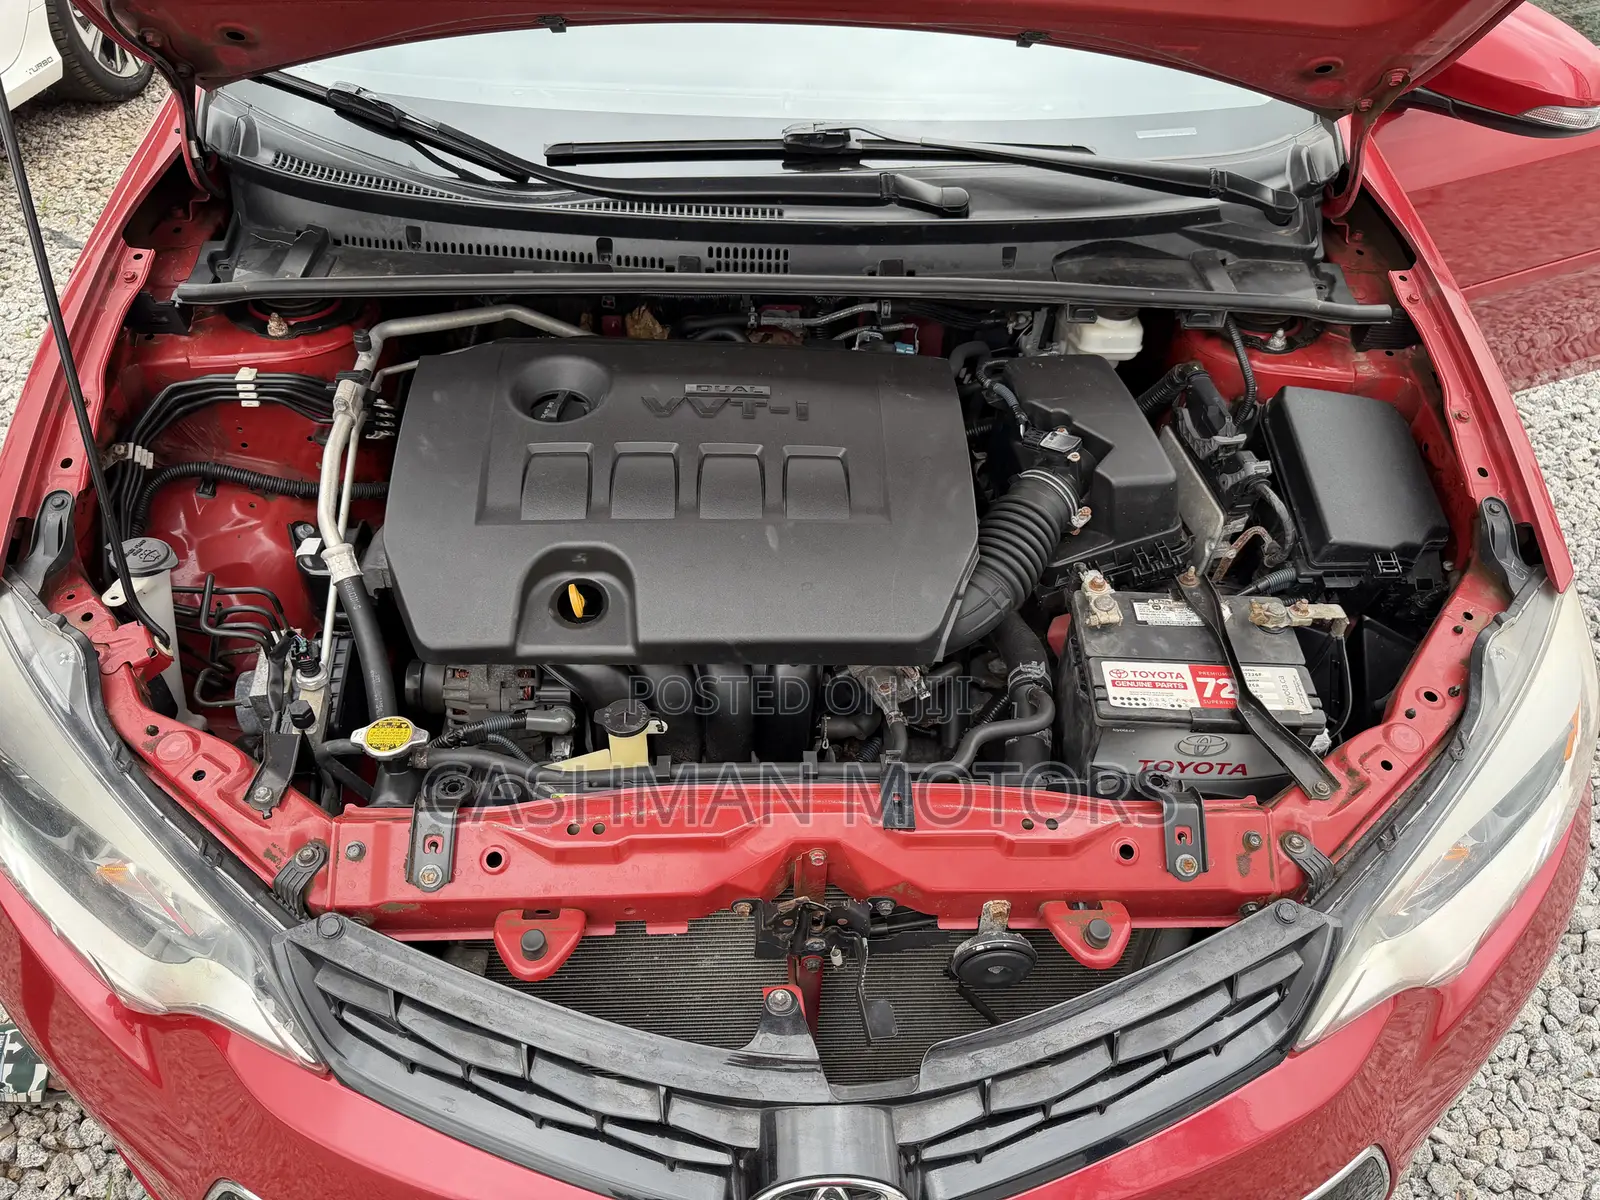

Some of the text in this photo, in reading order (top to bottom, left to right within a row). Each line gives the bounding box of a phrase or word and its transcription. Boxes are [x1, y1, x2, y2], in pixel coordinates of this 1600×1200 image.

[696, 385, 764, 394] DUAL
[1130, 670, 1185, 680] TOYOTA
[1115, 680, 1154, 688] GENUINE
[1196, 677, 1237, 699] 72
[1138, 759, 1248, 776] TOYOTA
